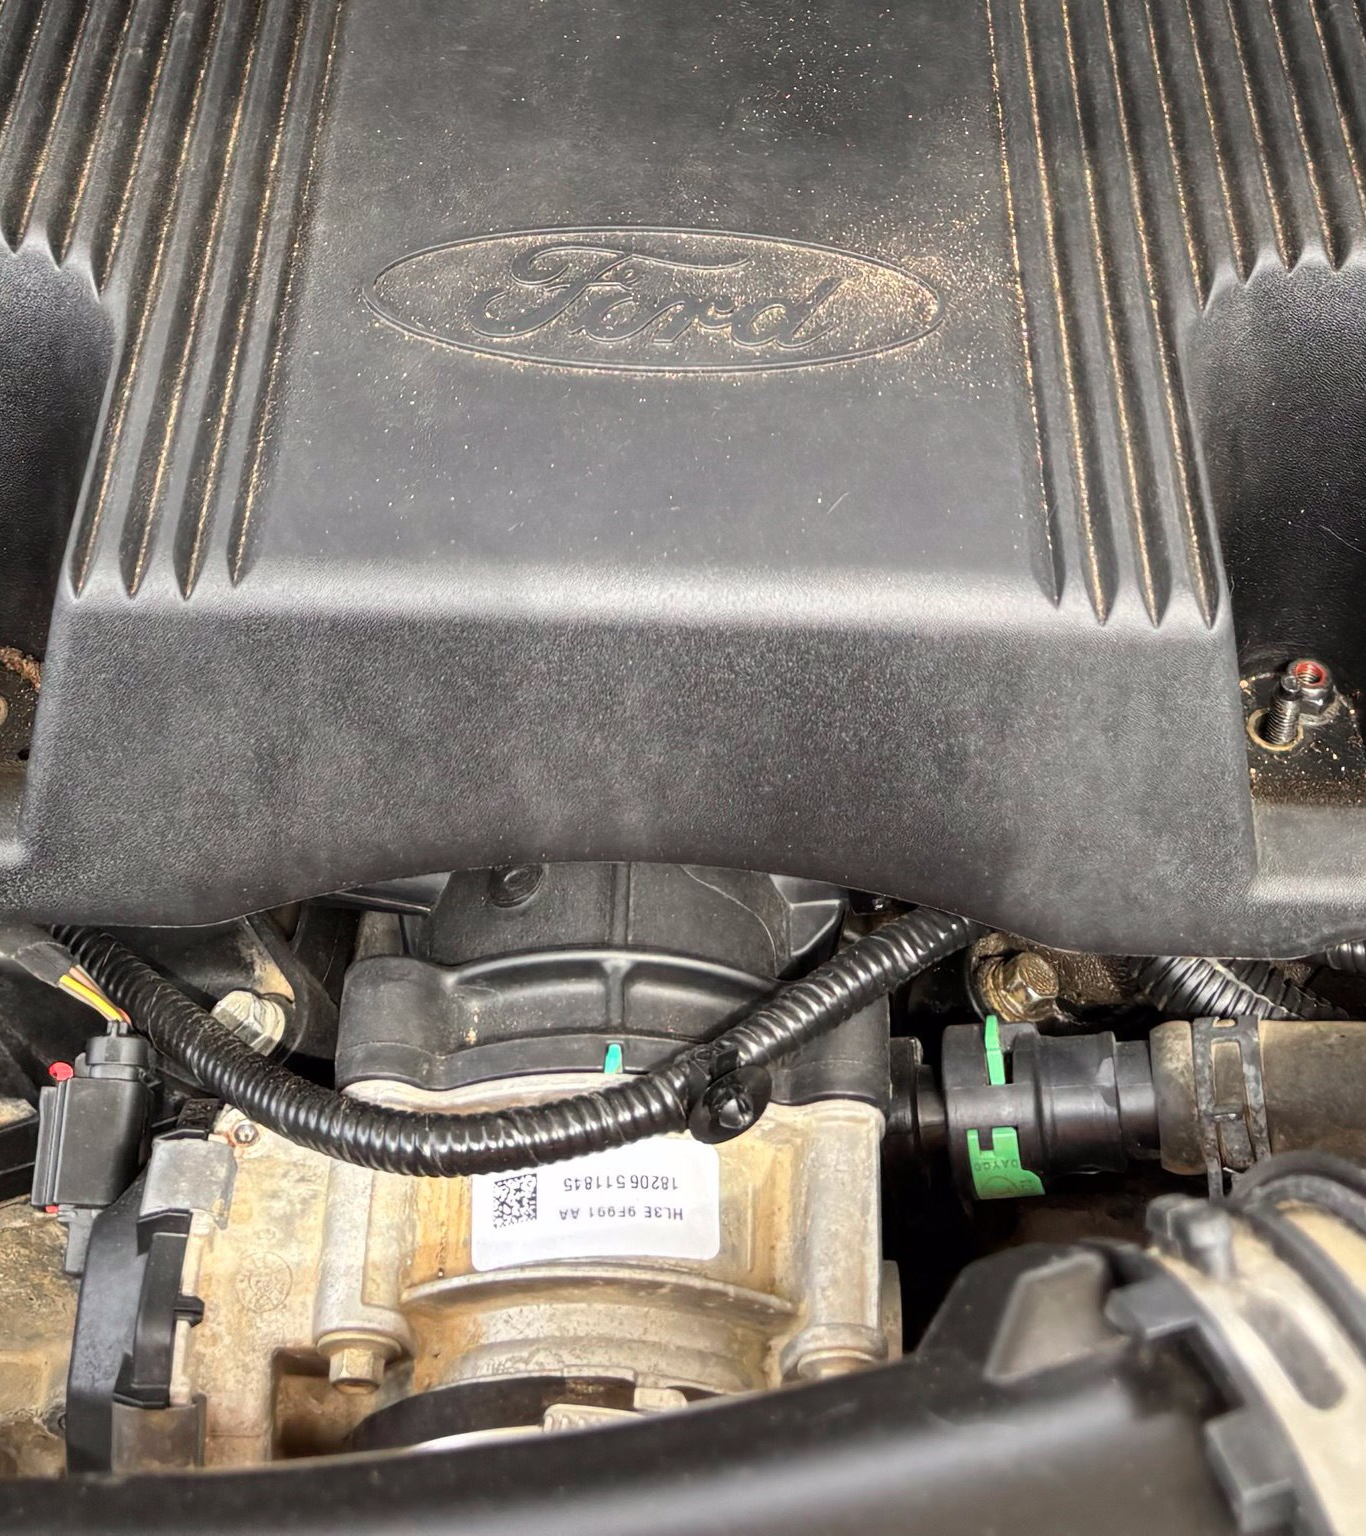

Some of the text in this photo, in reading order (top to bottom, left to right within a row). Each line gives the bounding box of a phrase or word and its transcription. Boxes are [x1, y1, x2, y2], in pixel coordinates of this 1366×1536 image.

[469, 244, 847, 351] Ford
[558, 1207, 581, 1221] AA
[644, 1206, 684, 1221] HL3E
